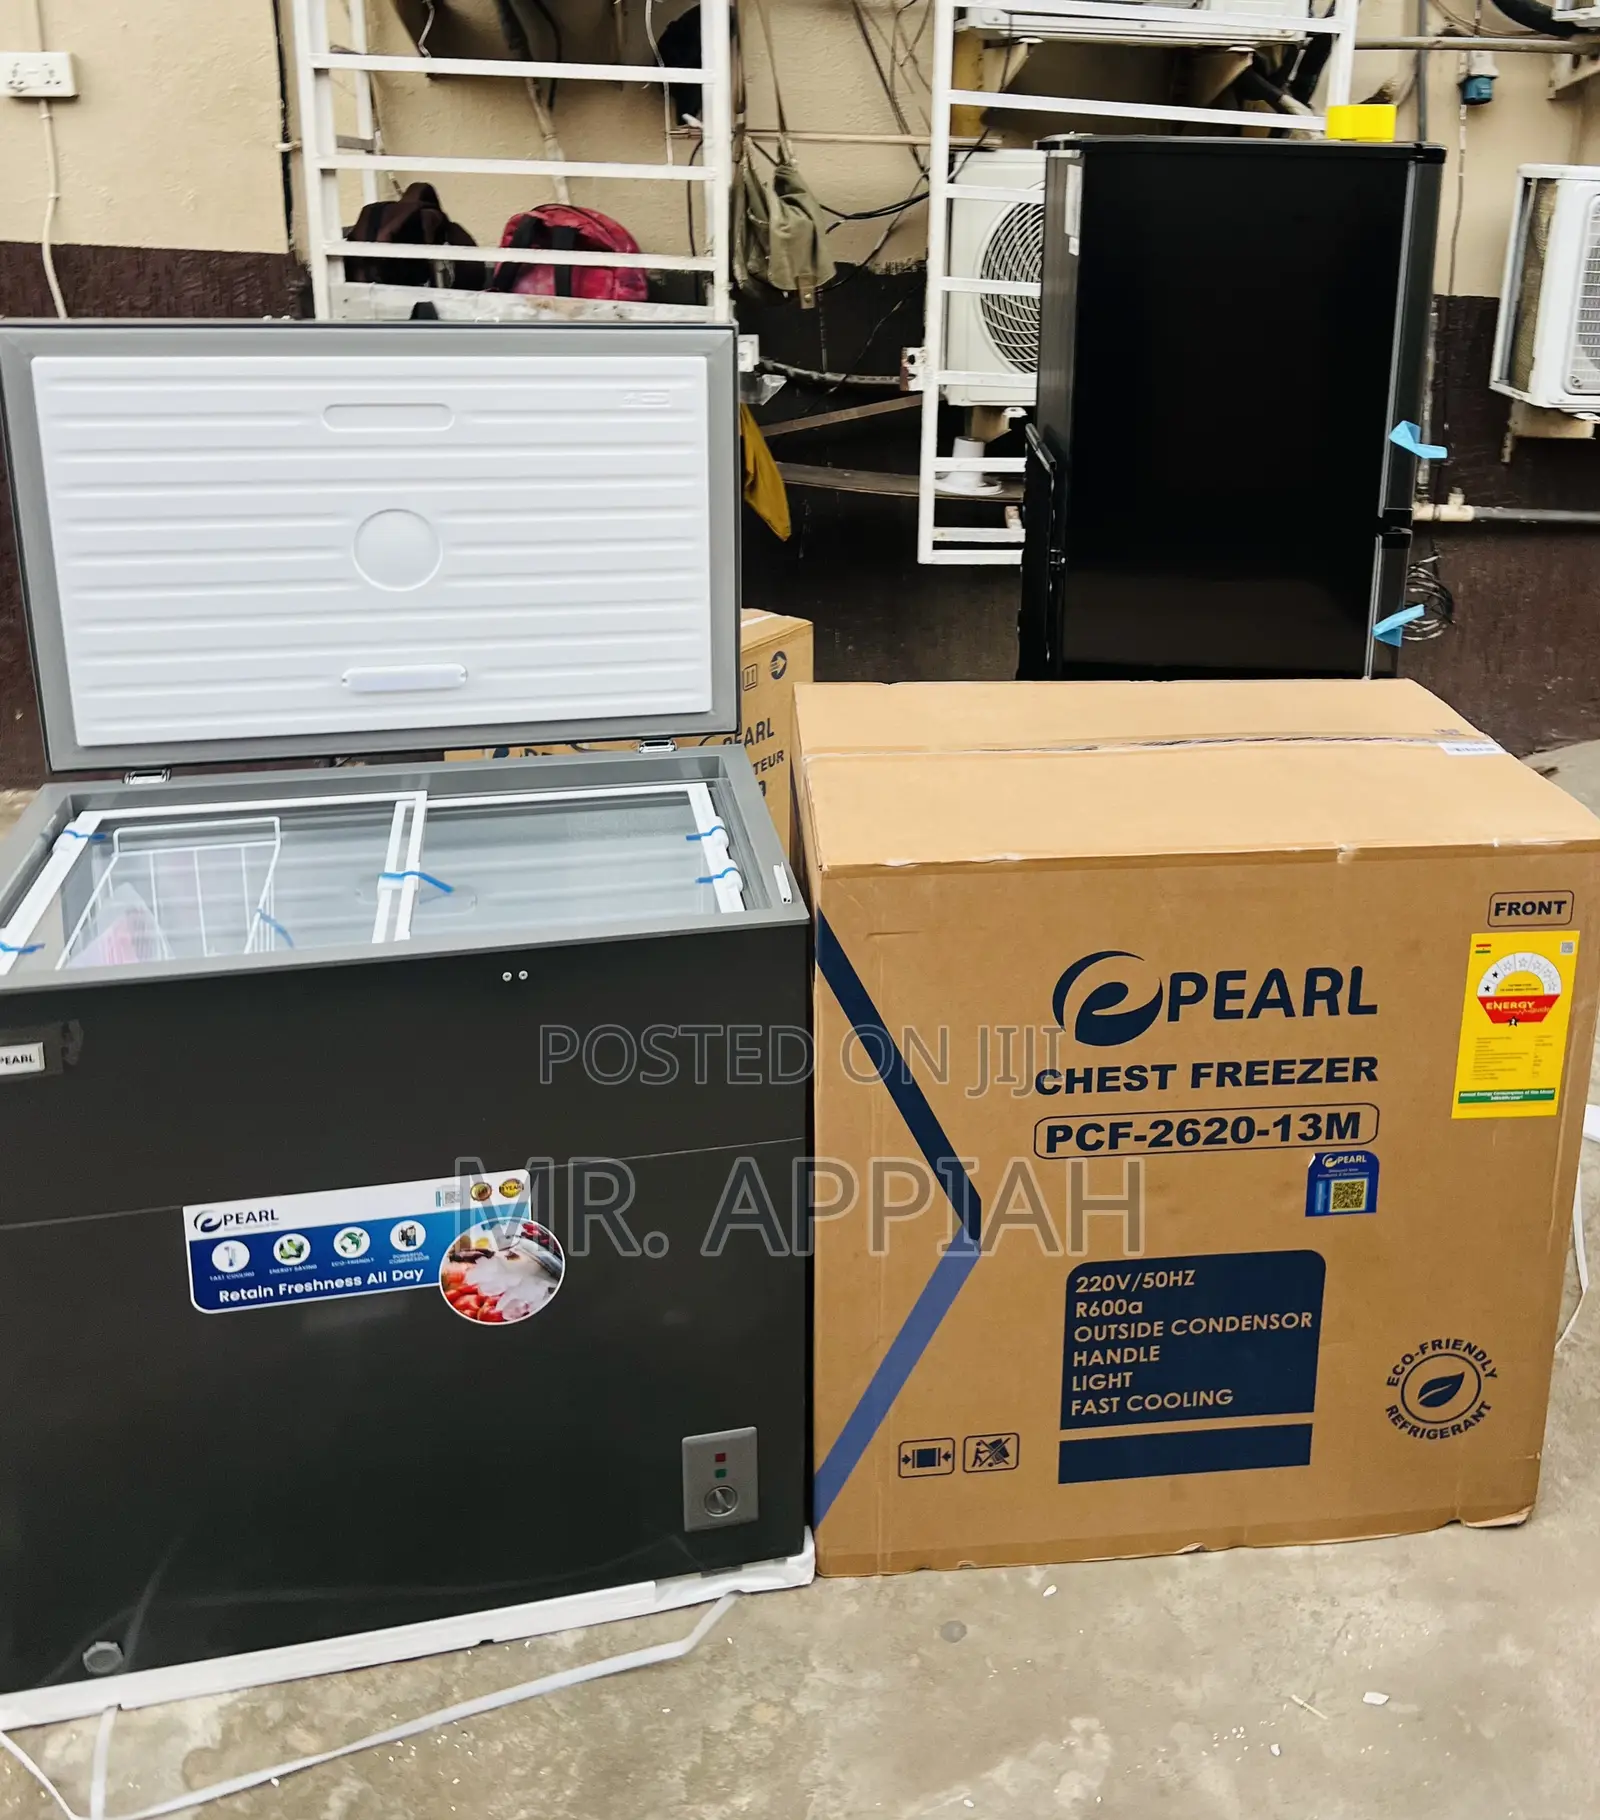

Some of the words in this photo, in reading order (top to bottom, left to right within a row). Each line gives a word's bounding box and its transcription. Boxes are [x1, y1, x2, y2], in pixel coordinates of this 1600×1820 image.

[1494, 900, 1567, 916] FRONT
[1168, 966, 1378, 1022] PEARL
[1485, 1001, 1535, 1011] ENERGY
[1035, 1064, 1177, 1095] CHEST
[1191, 1056, 1379, 1088] FREEZER
[1046, 1112, 1361, 1153] PCF-2620-13M
[1337, 1155, 1367, 1164] PEARL
[223, 1209, 279, 1226] PEARL
[219, 1286, 273, 1303] Retain
[279, 1276, 362, 1294] Freshness
[367, 1272, 387, 1285] All
[392, 1268, 424, 1282] Day
[1075, 1269, 1196, 1293] 220V/50HZ
[1075, 1299, 1144, 1319] R600a
[1074, 1320, 1165, 1343] OUTSIDE
[1170, 1311, 1313, 1336] CONDENSOR
[1072, 1345, 1160, 1368] HANDLE
[1386, 1338, 1497, 1387] ECO-FRIENDLY
[1072, 1371, 1134, 1392] LIGHT
[1071, 1397, 1121, 1417] FAST
[1126, 1389, 1234, 1412] COOLING
[1386, 1400, 1492, 1440] REFRIGERANT
